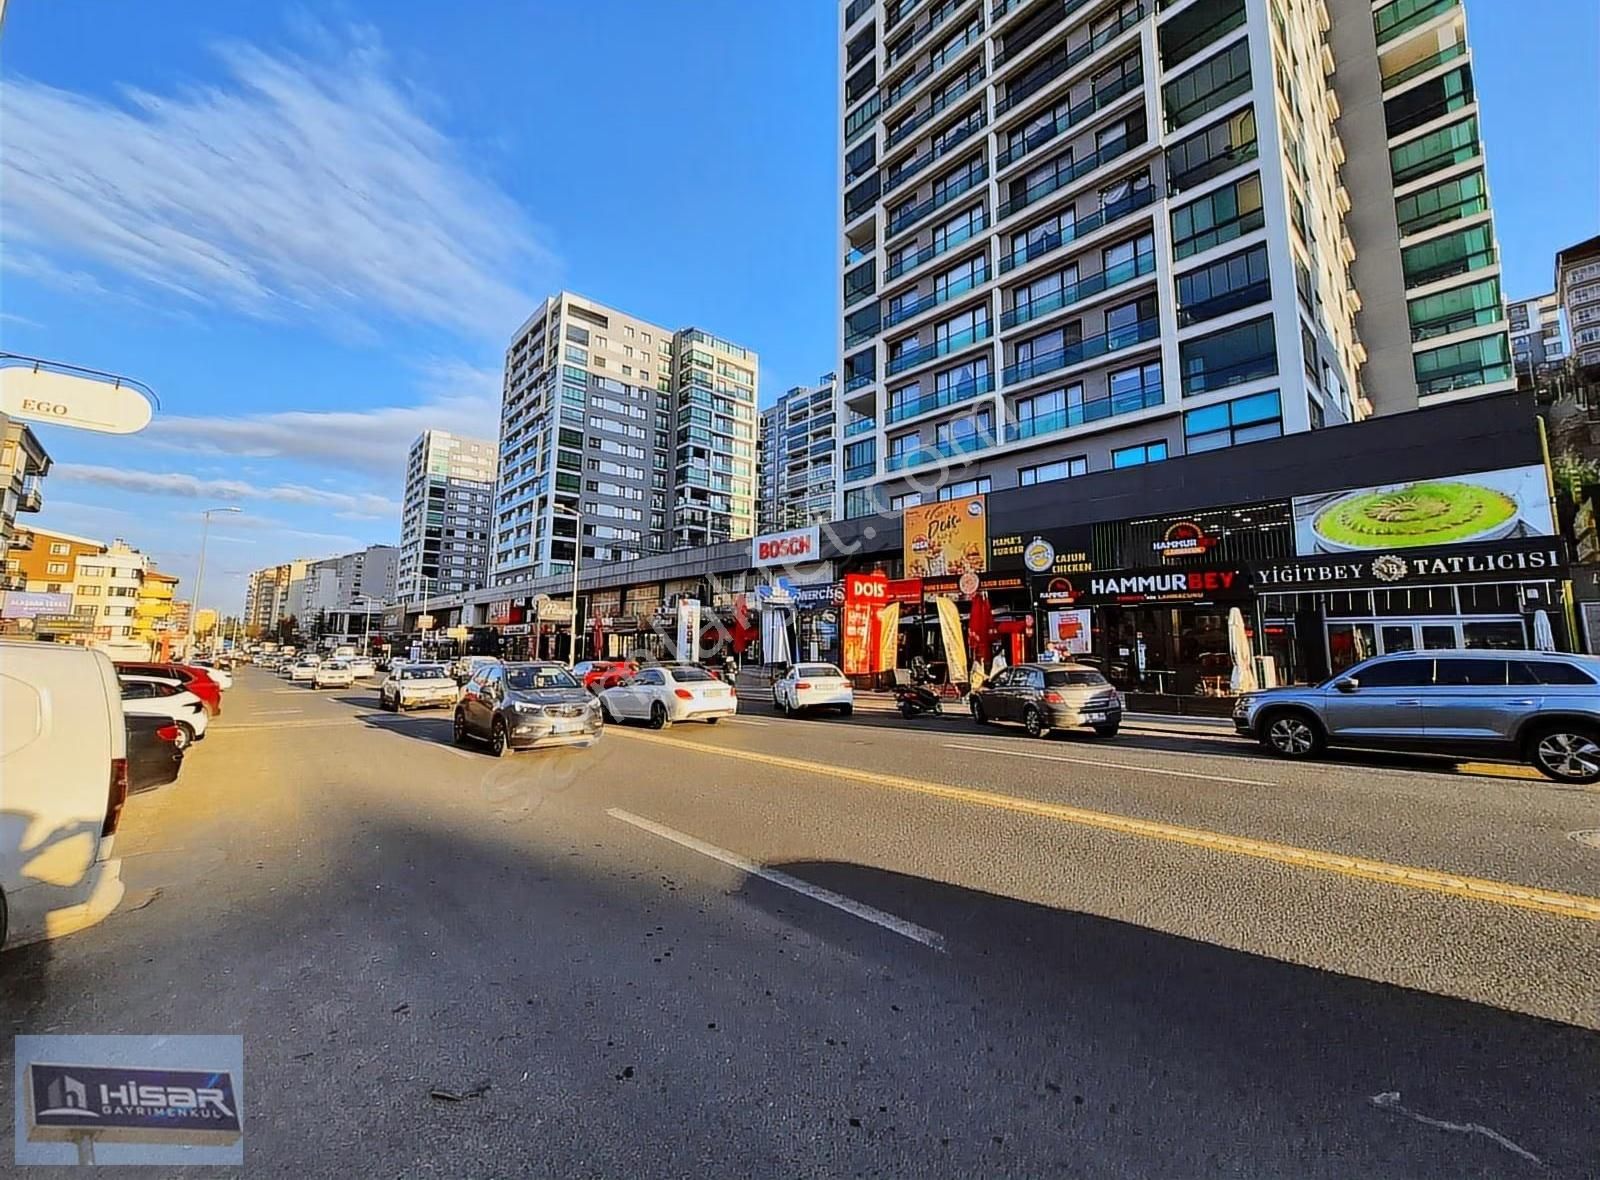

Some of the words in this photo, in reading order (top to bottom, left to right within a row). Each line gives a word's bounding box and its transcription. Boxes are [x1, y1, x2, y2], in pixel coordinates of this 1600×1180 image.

[22, 398, 68, 416] EGO
[759, 535, 811, 560] BOSCH
[993, 545, 1025, 556] BURGER
[1055, 552, 1086, 563] CAJUN
[1052, 562, 1092, 574] CHICKEN
[1258, 563, 1363, 584] YİĞİTBEY
[1413, 550, 1560, 575] TATLICISI
[853, 580, 885, 598] DOIS
[1091, 571, 1234, 595] HAMMURBEY
